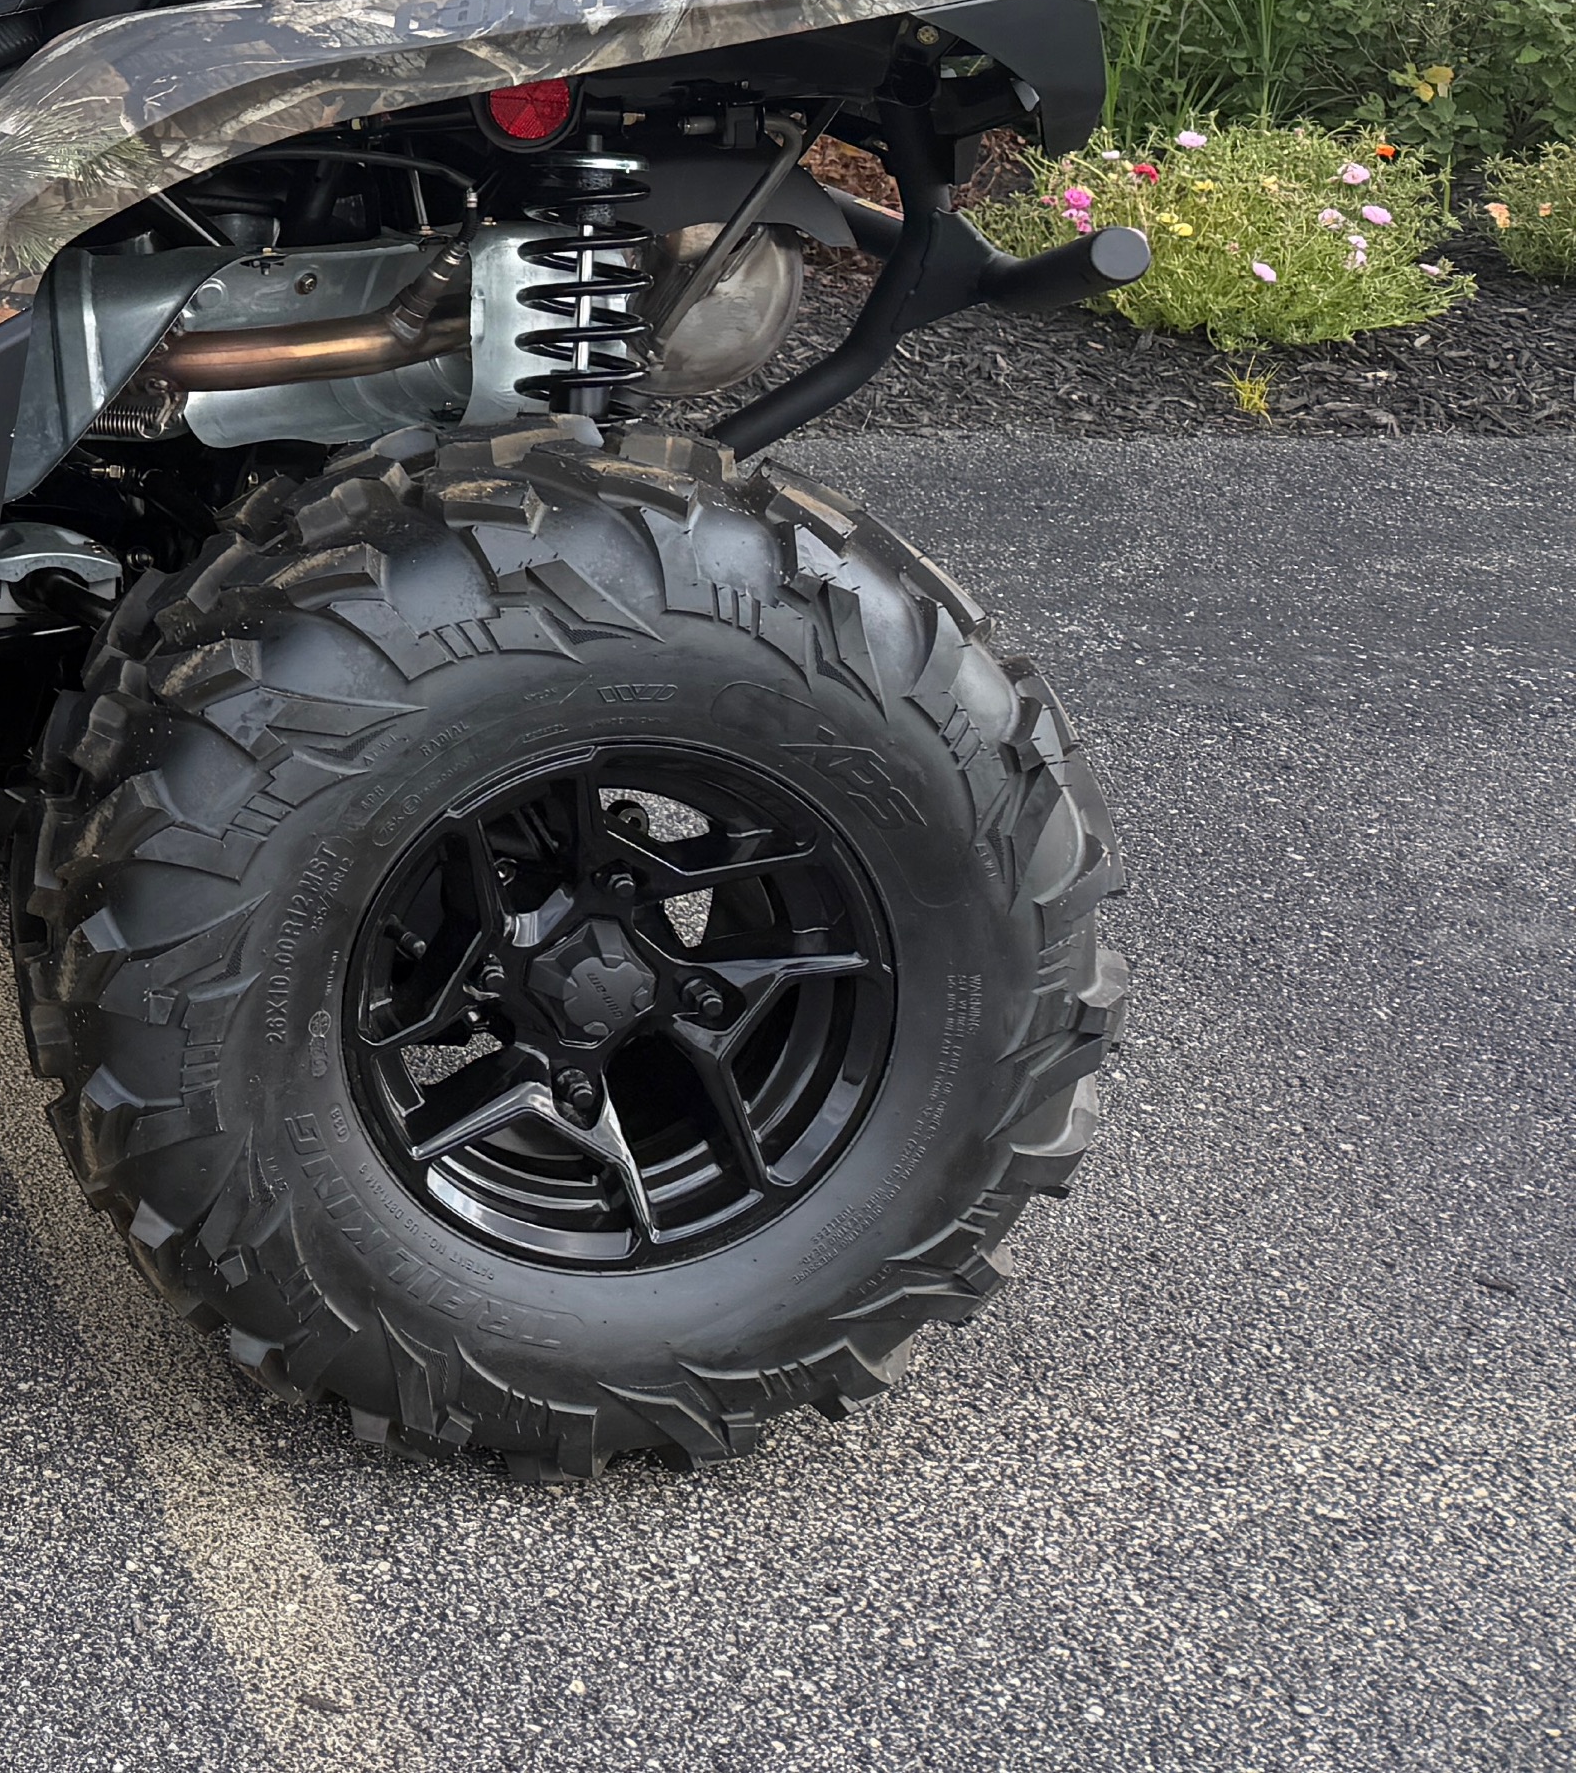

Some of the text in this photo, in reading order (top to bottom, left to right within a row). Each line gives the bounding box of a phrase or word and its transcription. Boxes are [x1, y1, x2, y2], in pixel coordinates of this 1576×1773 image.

[416, 718, 472, 758] RADIAL
[778, 724, 928, 830] XPS
[296, 838, 341, 896] MST
[275, 1106, 566, 1354] TRAIL KING
